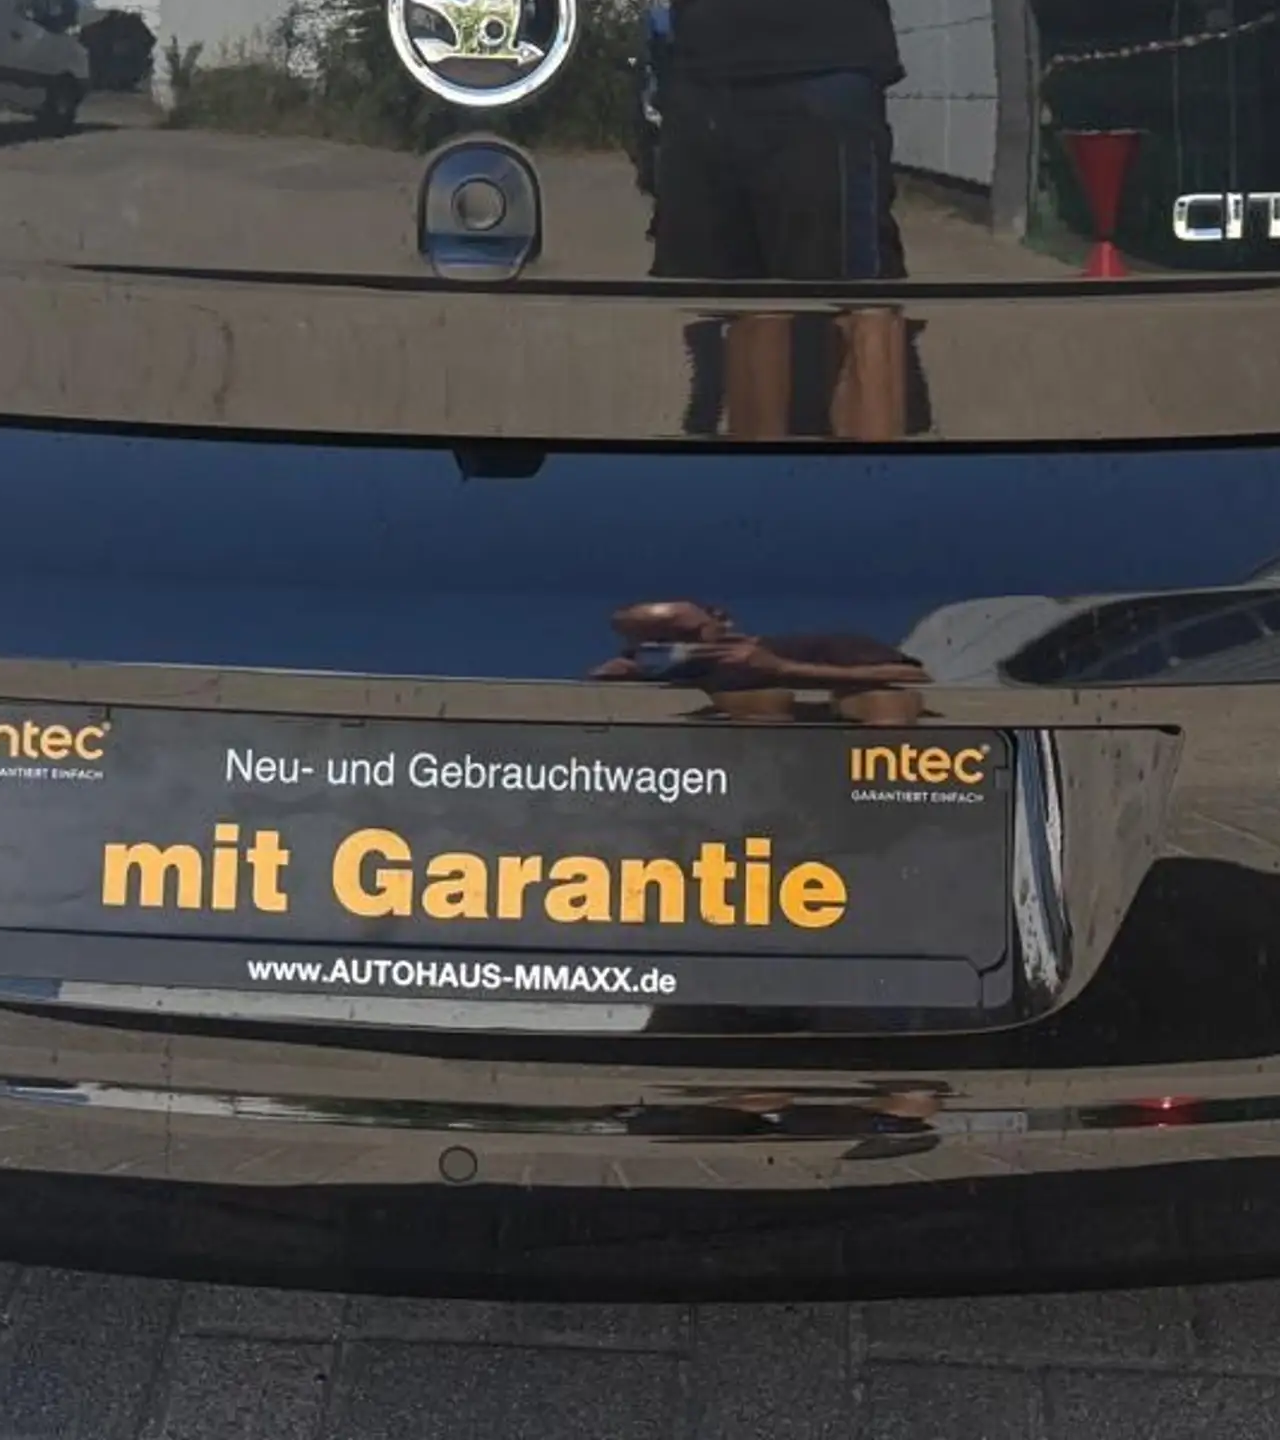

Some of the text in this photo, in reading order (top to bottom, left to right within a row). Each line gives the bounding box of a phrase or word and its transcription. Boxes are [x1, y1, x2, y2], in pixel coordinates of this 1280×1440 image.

[51, 767, 104, 780] EINFACH
[226, 748, 728, 803] Neu- und Gebrauchtwagen
[851, 744, 985, 785] intec
[850, 789, 984, 804] GARANTIERT EINFACH
[102, 824, 848, 928] mit Garantie
[248, 958, 677, 995] www.AUTOHAUS-MMAXX.de
